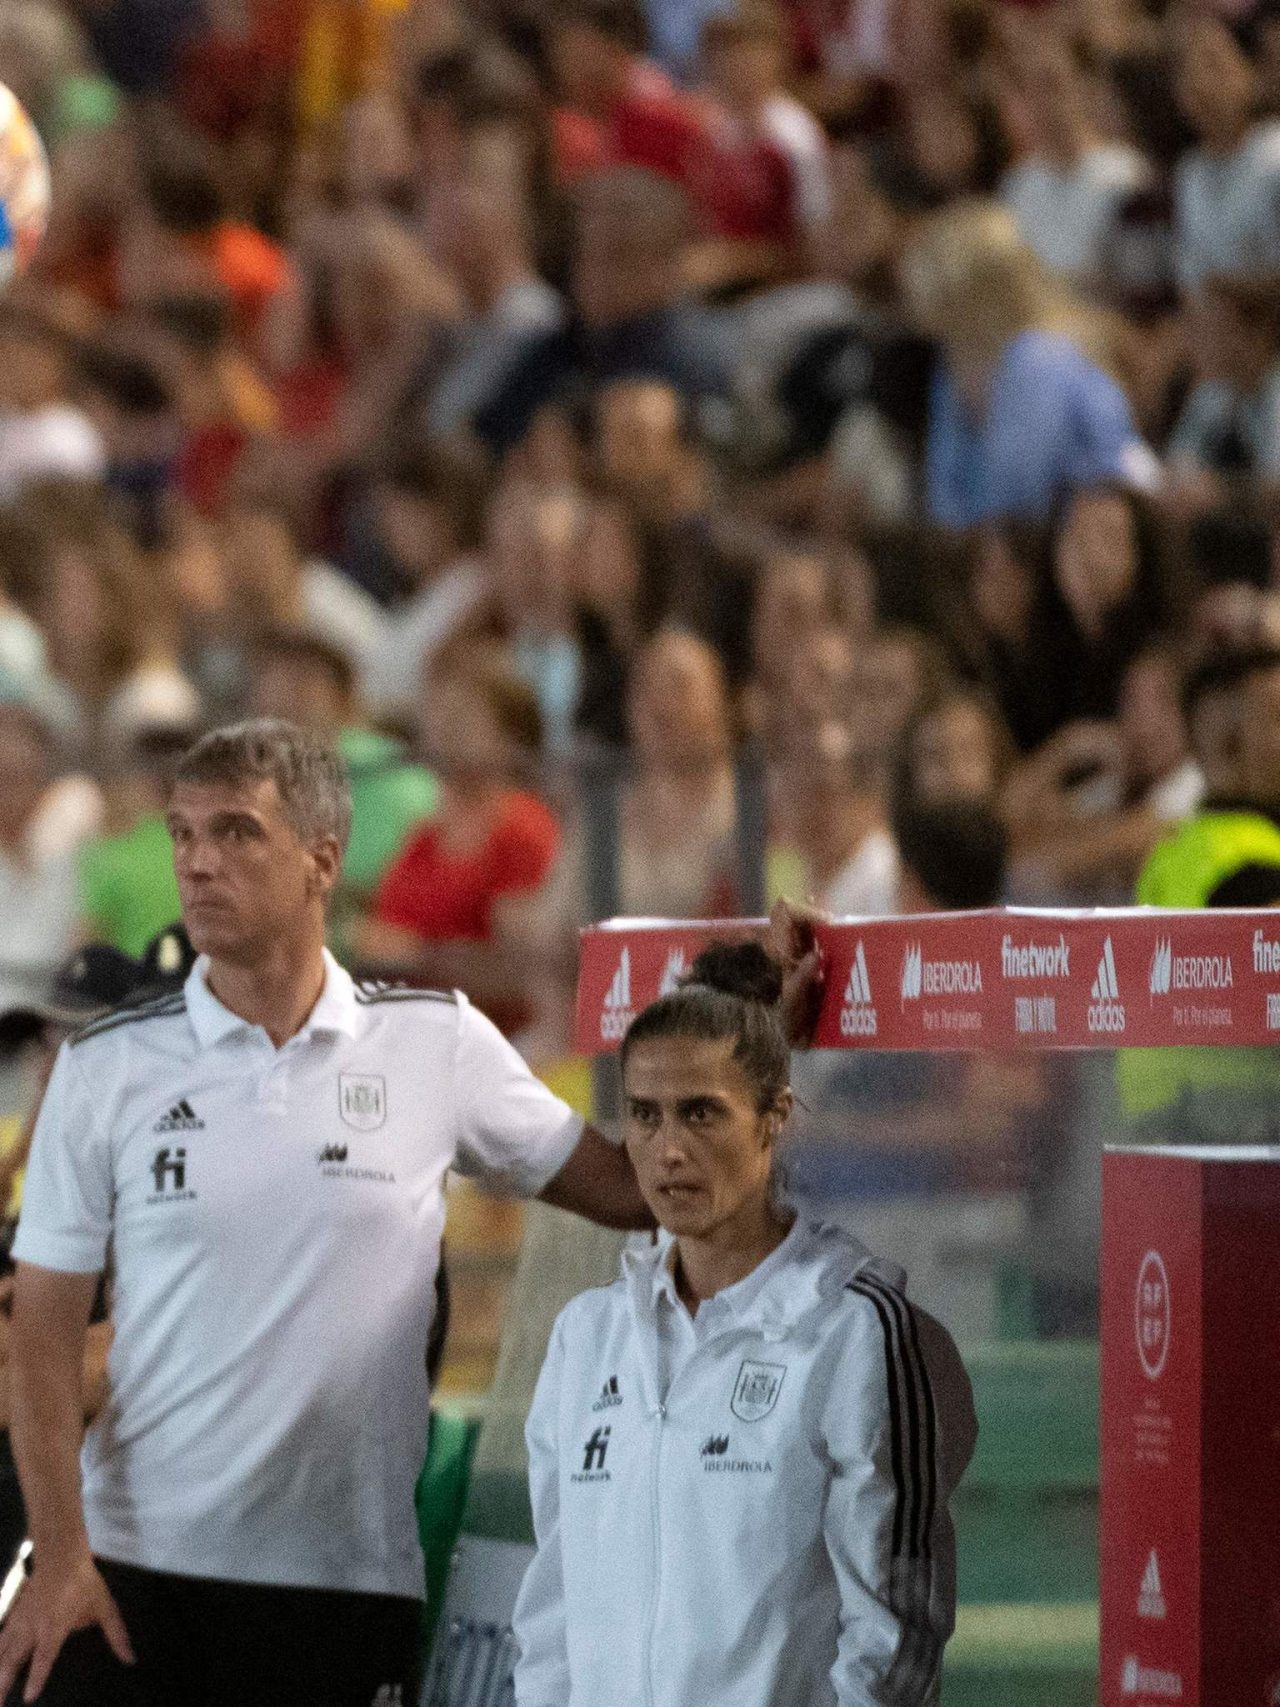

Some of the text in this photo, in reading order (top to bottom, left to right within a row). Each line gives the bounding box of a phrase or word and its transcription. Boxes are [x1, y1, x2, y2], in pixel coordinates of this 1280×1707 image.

[1001, 933, 1070, 978] finetwork
[1172, 955, 1234, 988] IBERDROLA
[923, 960, 983, 993] IBERDROLA
[840, 1003, 877, 1036] adidas
[1087, 1002, 1126, 1032] adidas
[151, 1147, 187, 1192] fi
[583, 1425, 611, 1470] fi
[704, 1460, 773, 1474] IBERDROLA
